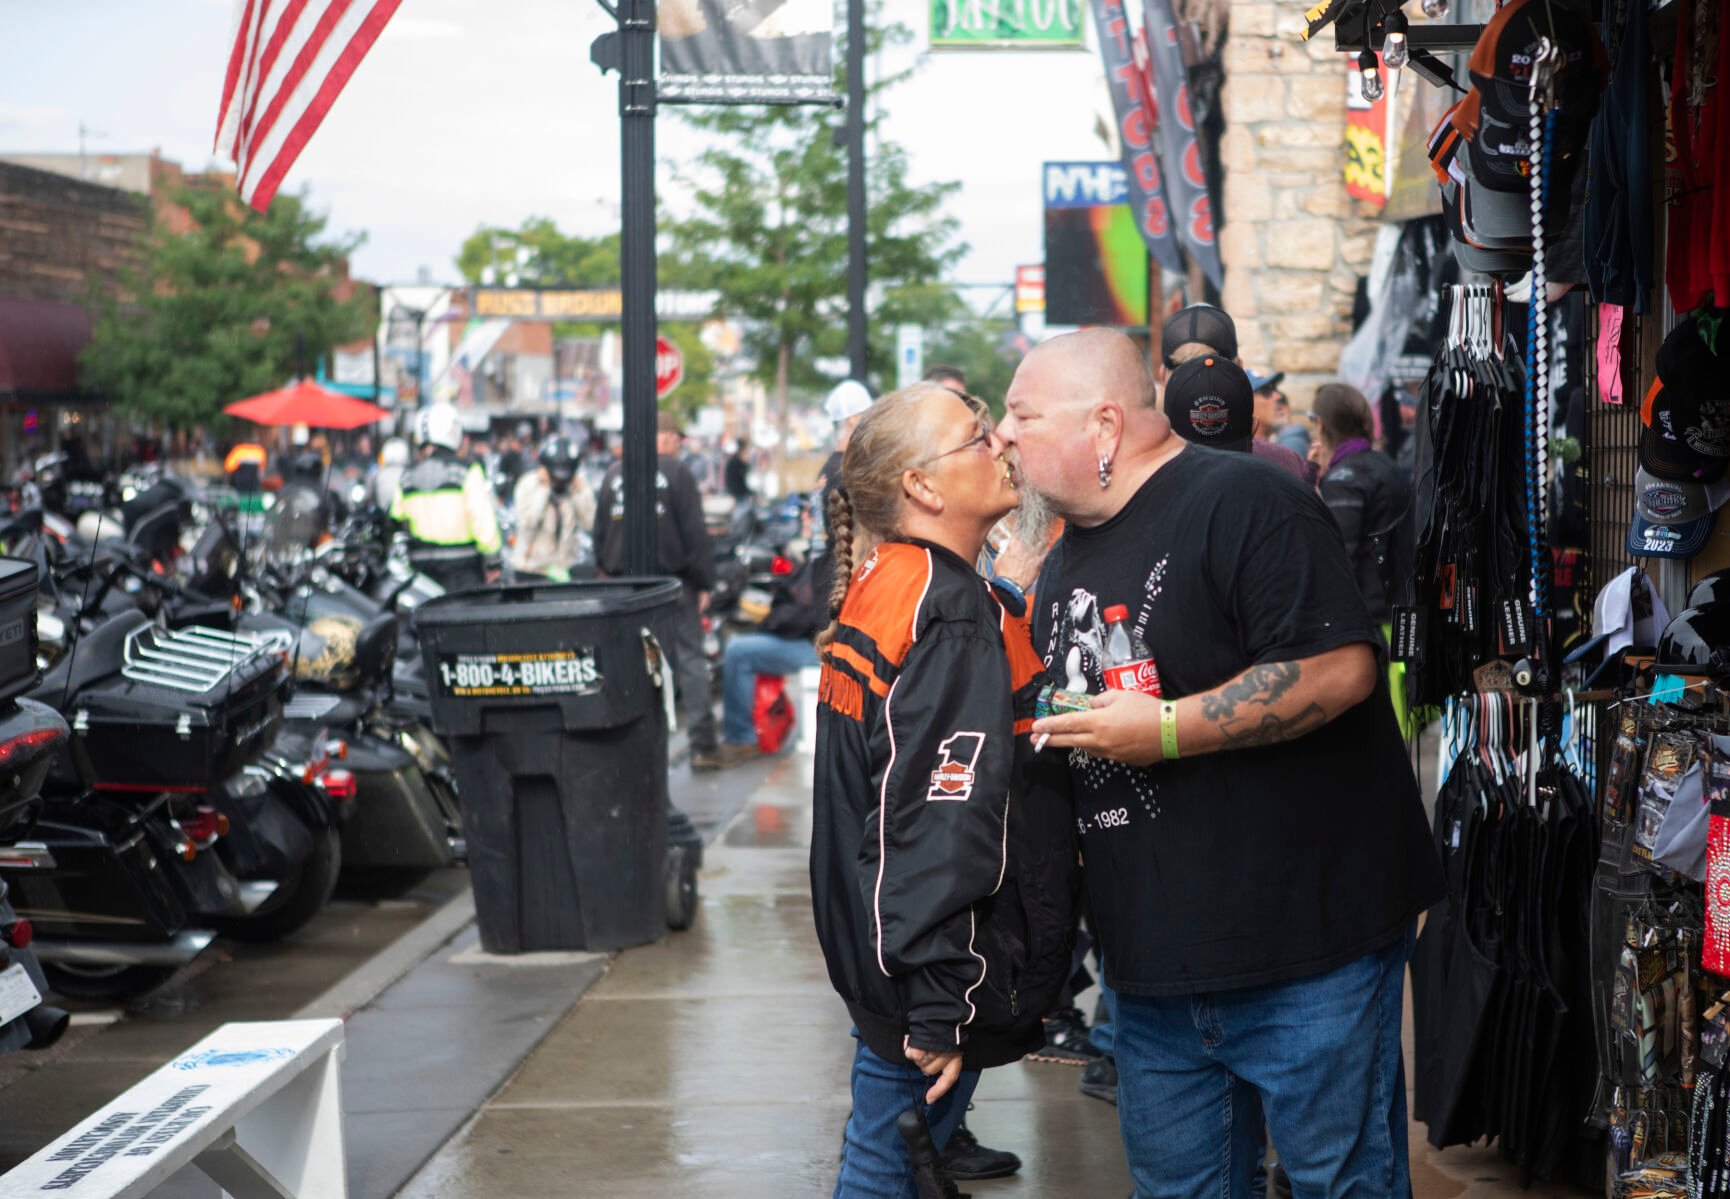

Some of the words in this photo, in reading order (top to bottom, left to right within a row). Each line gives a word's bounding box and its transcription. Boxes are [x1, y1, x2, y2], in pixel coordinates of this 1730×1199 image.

[684, 87, 724, 96] STURGIS
[750, 87, 790, 96] STURGIS
[725, 75, 764, 84] STURGIS
[790, 75, 829, 84] STURGIS
[1194, 395, 1226, 406] GENUINE
[1643, 538, 1675, 552] 2023
[1503, 601, 1516, 645] LEATHER
[1514, 599, 1527, 644] GENUINE
[1398, 613, 1407, 657] LEATHER
[1408, 613, 1417, 657] GENUINE
[440, 657, 597, 687] 1-800-4-BIKERS
[1094, 807, 1130, 829] 1982
